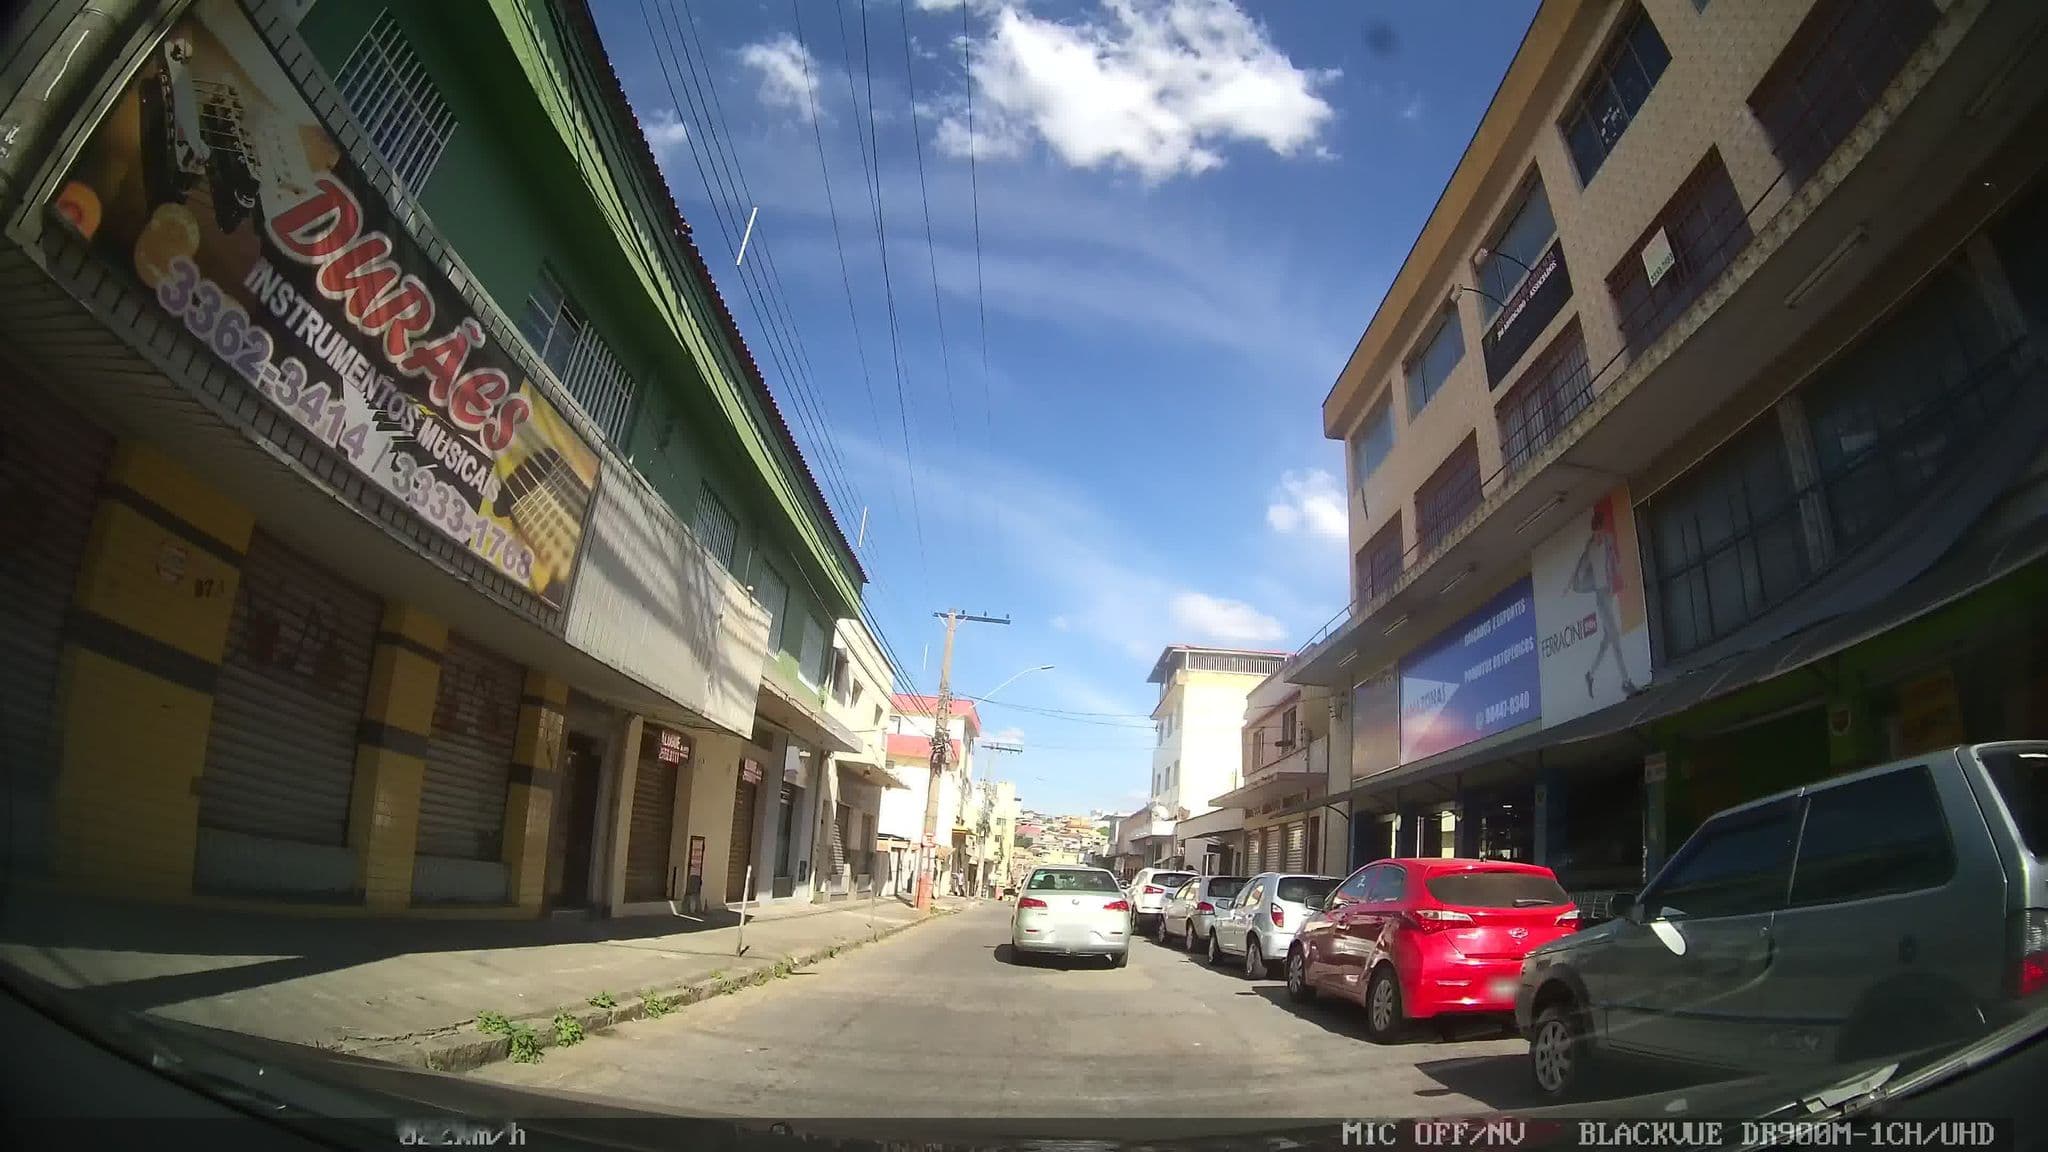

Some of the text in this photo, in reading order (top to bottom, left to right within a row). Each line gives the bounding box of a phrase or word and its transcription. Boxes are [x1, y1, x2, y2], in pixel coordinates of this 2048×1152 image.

[158, 256, 371, 462] 3362-3414
[390, 452, 534, 581] 3333-1768
[244, 256, 419, 433] INSTRUMENTOS
[1541, 620, 1583, 658] FERRACINI
